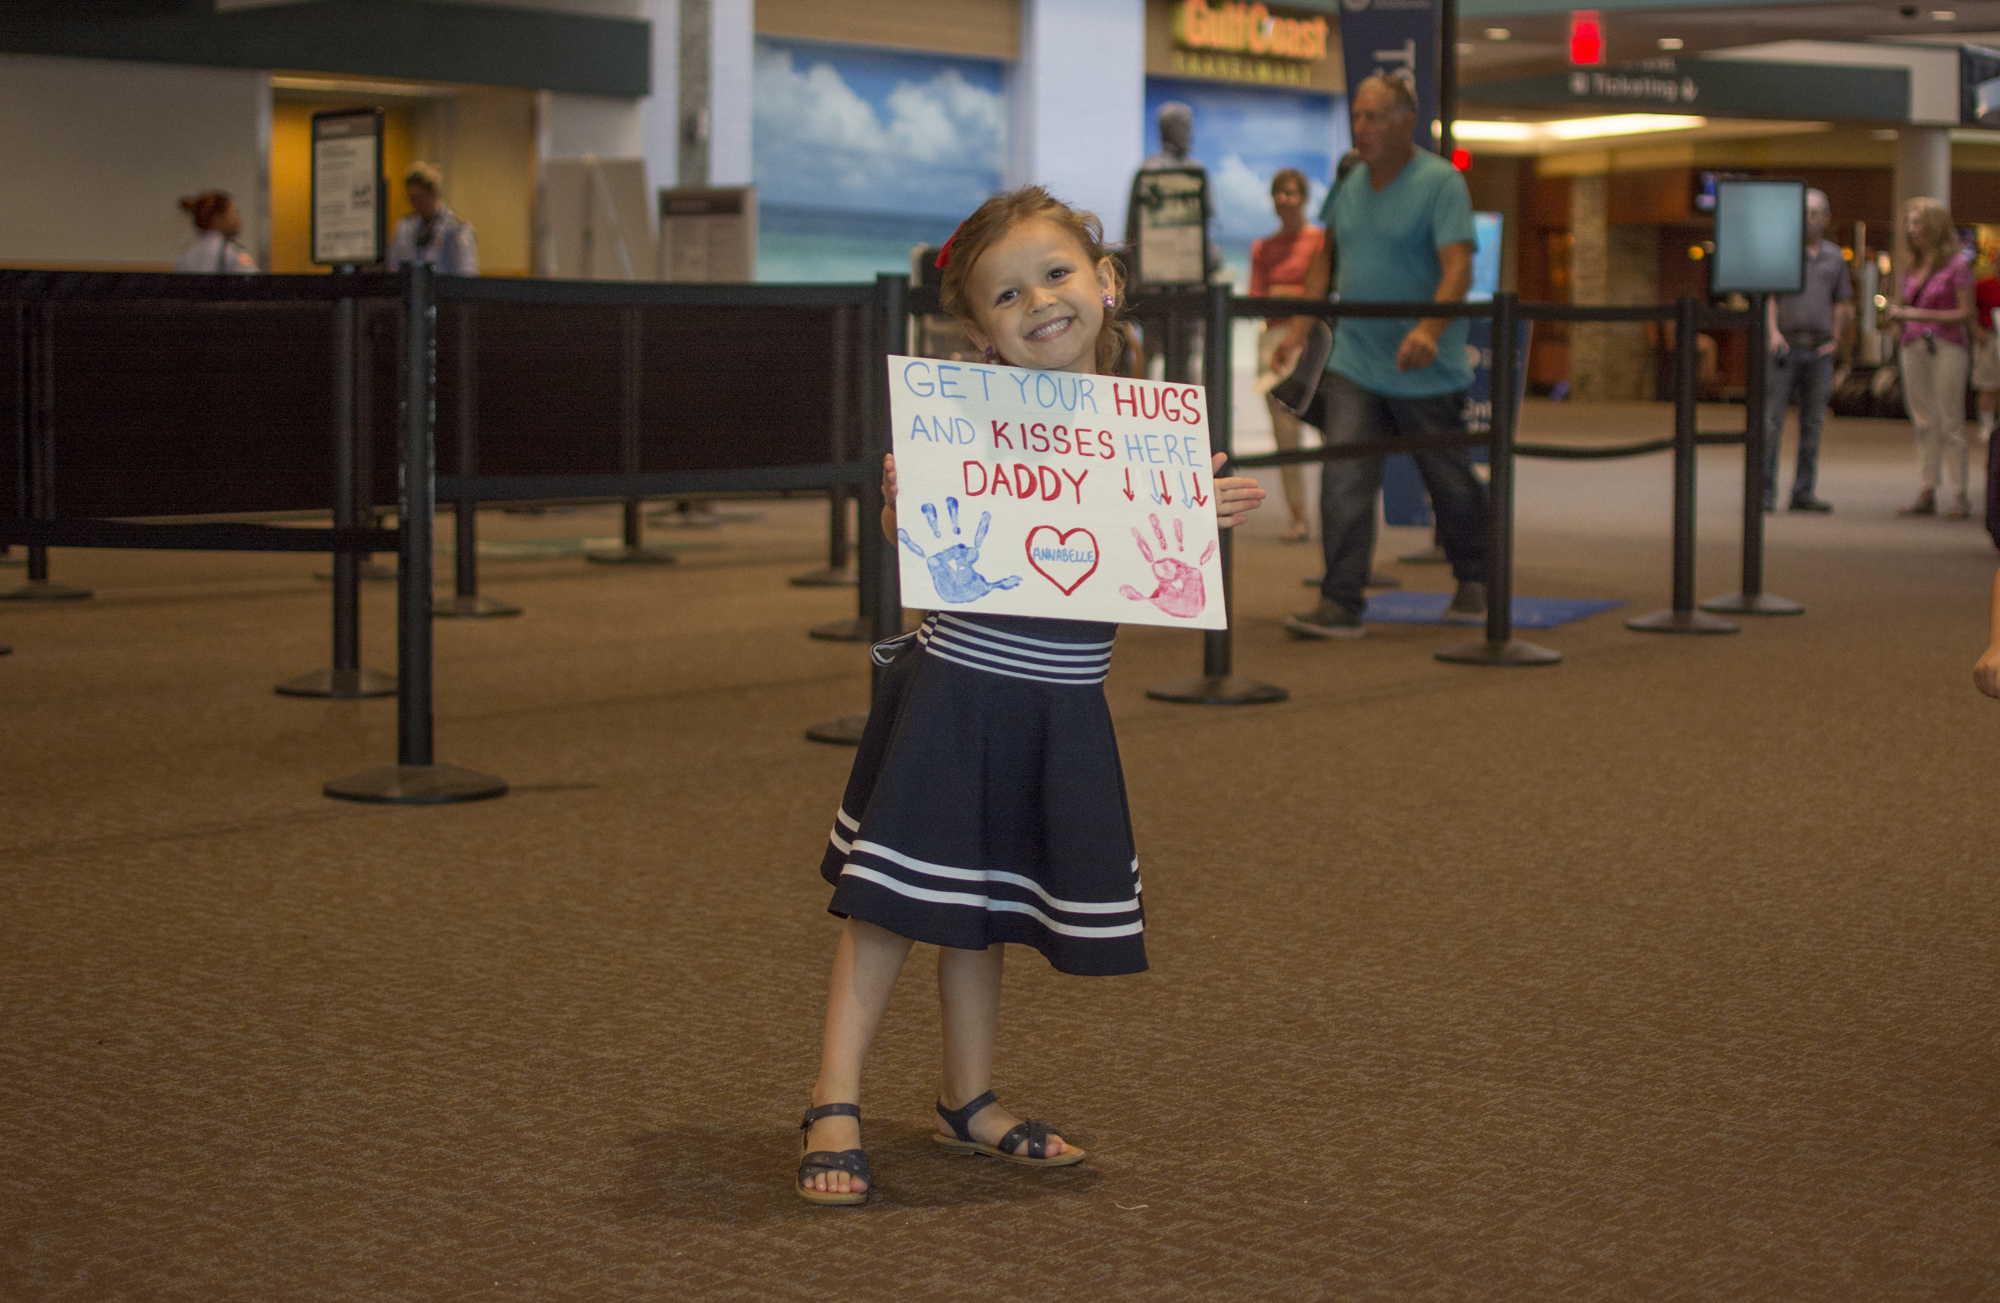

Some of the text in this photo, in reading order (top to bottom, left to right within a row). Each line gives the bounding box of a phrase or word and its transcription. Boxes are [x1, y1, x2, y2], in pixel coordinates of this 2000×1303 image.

[1592, 73, 1678, 102] Ticketing
[904, 361, 1201, 425] GET YOUR HUGS
[910, 414, 1203, 467] AND KISSES HERE
[963, 460, 1089, 504] DADDY
[1032, 546, 1096, 563] ANNABELLE
